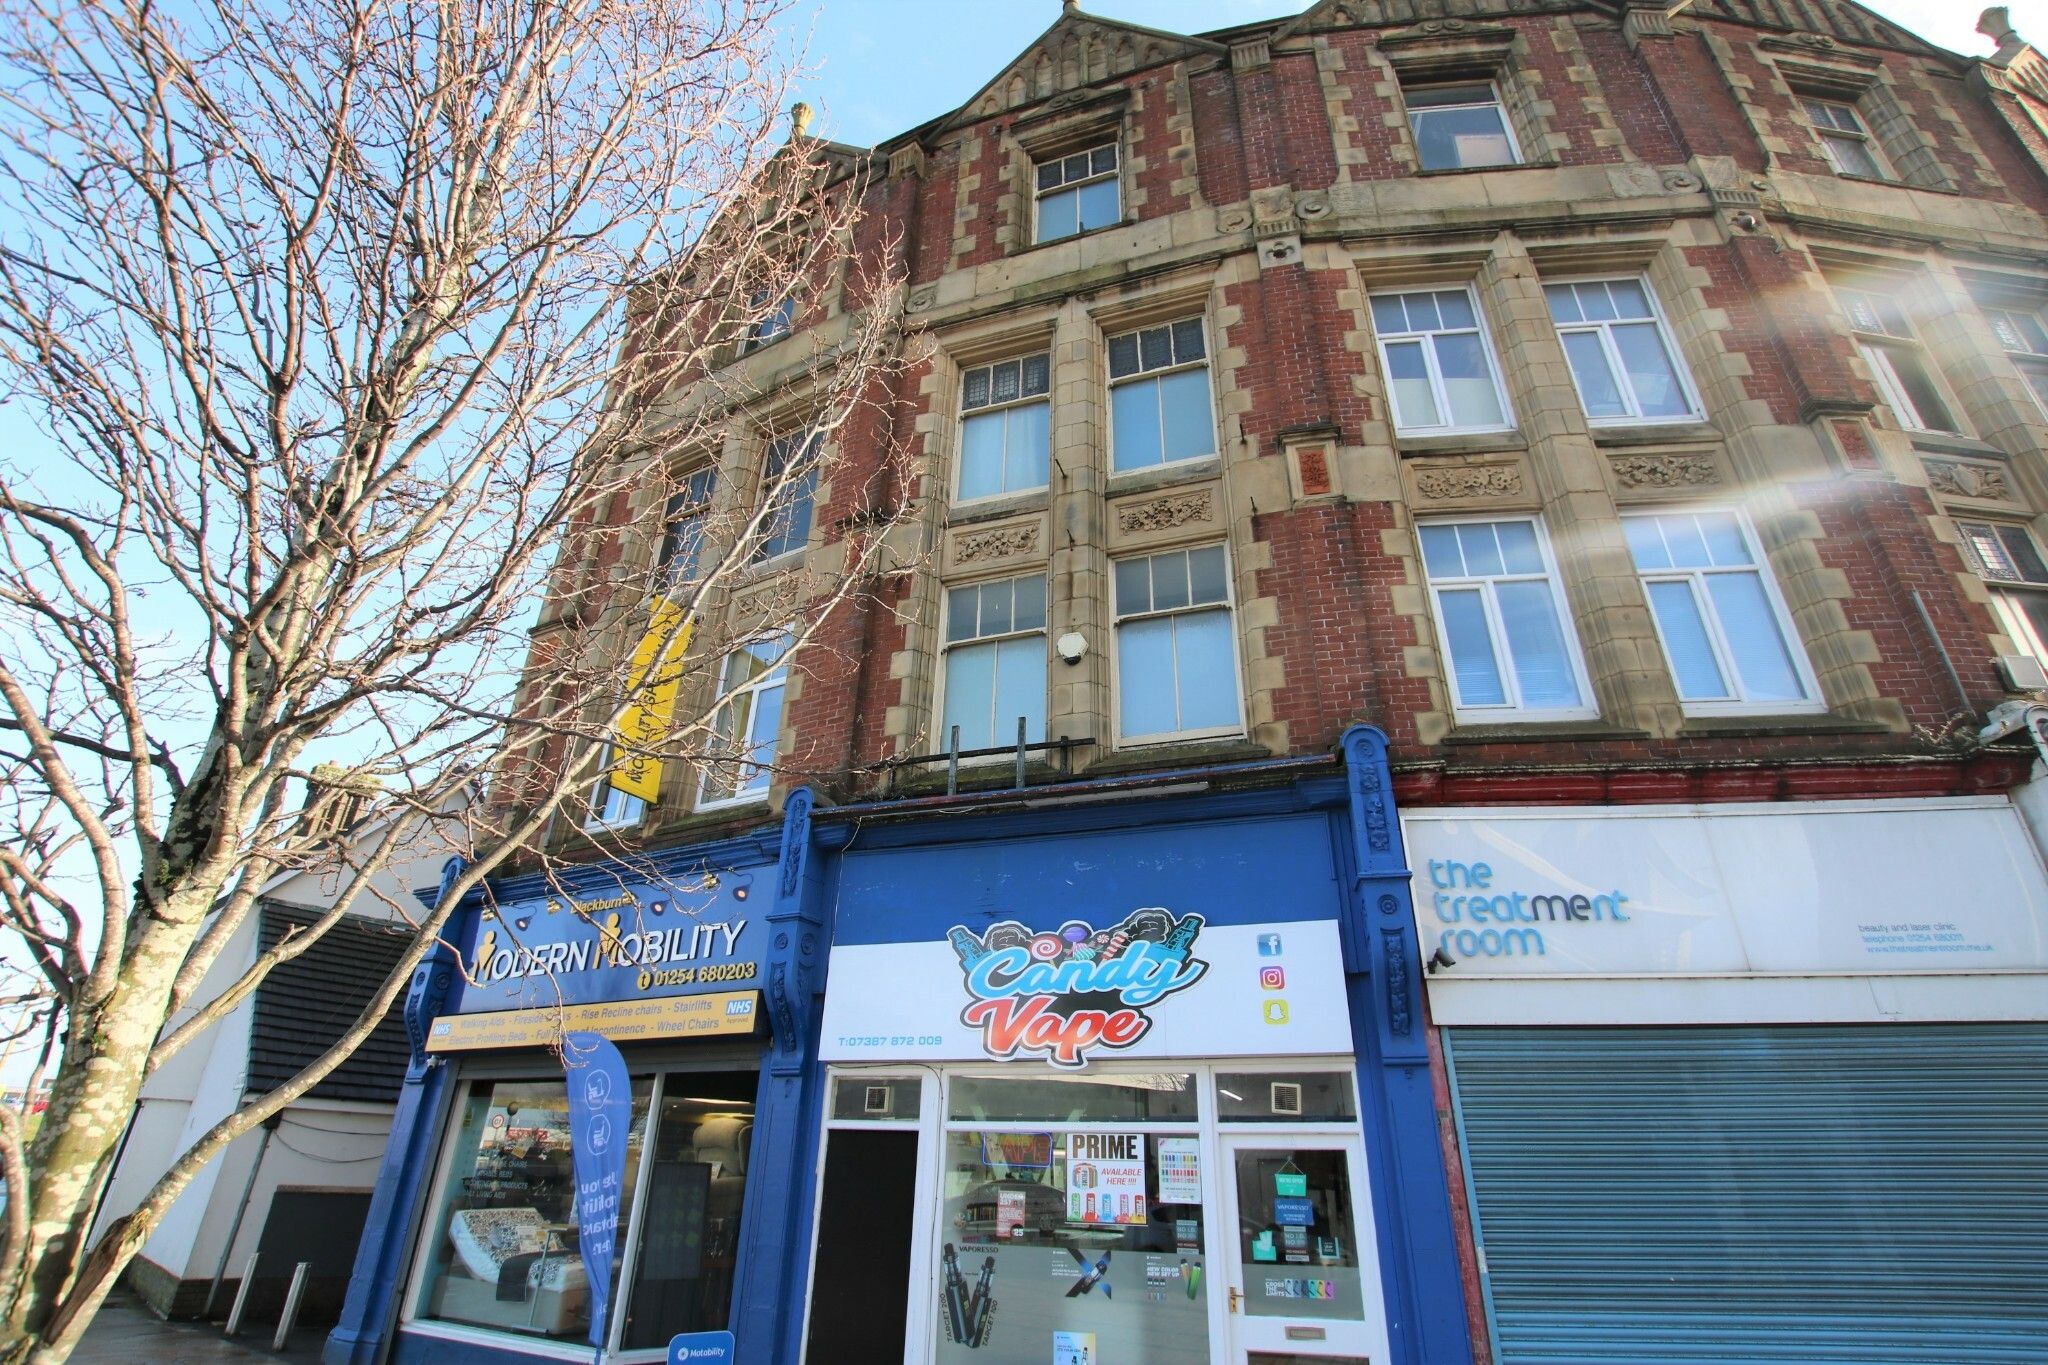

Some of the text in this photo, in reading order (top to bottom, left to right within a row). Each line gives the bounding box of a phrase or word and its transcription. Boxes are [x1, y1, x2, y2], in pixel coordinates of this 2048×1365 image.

[1428, 859, 1493, 889] the
[1858, 922, 1957, 933] beauty and laser clinic
[592, 912, 746, 969] MOBILITY
[1440, 928, 1545, 956] room
[655, 967, 695, 986] 01254
[700, 962, 757, 983] 680203
[970, 940, 1206, 1005] Candy
[581, 1008, 599, 1020] Rise
[602, 1006, 633, 1018] Recline
[635, 1003, 662, 1015] chairs
[674, 1000, 712, 1012] Stairlifts
[727, 1000, 752, 1015] NHS
[434, 1023, 451, 1035] NHS
[508, 1030, 527, 1041] Beds
[657, 1019, 686, 1032] Wheel
[688, 1017, 719, 1030] Chairs
[966, 995, 1146, 1061] Vape
[1072, 1134, 1138, 1159] PRIME
[1101, 1168, 1142, 1177] AVAILABLE
[1107, 1177, 1125, 1185] HERE
[939, 1293, 953, 1343] TARGET 200
[981, 1315, 994, 1347] TARGET
[690, 1347, 725, 1358] Motability
